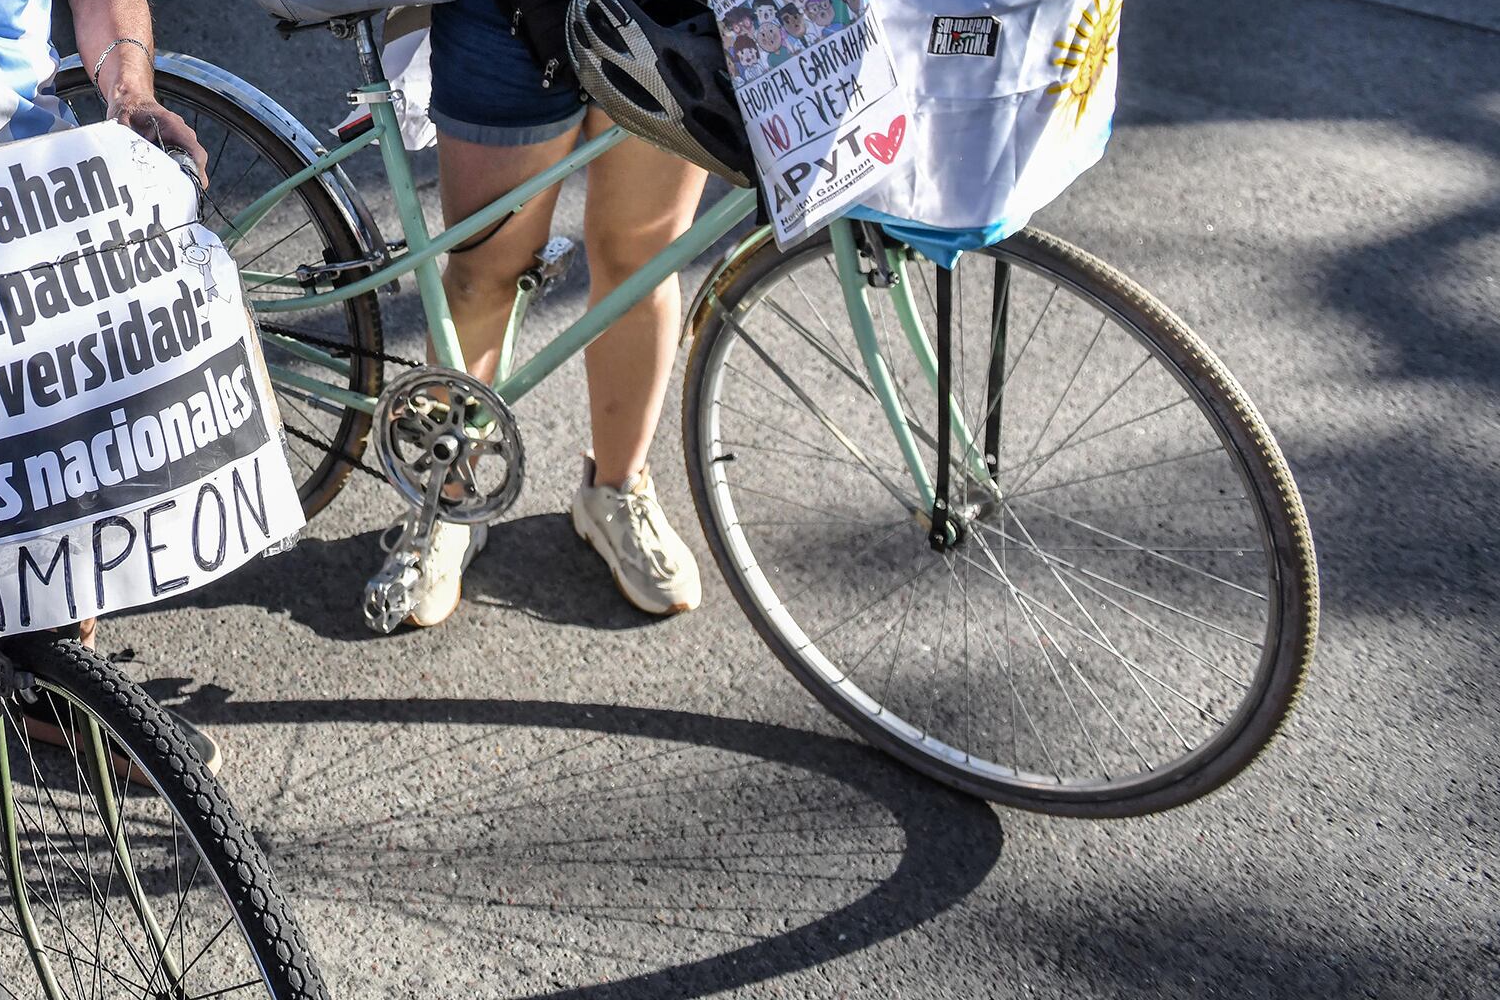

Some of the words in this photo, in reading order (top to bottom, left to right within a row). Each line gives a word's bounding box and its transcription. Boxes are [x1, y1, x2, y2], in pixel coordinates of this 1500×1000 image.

[739, 66, 803, 120] HOSPITAL
[799, 16, 879, 87] GARRAHAN
[933, 33, 990, 55] PALESTINA
[760, 113, 791, 157] NO
[790, 100, 816, 143] SE
[806, 73, 866, 126] VETA
[774, 125, 864, 213] APyT
[816, 158, 871, 197] Garrahan
[24, 362, 253, 511] nacionales
